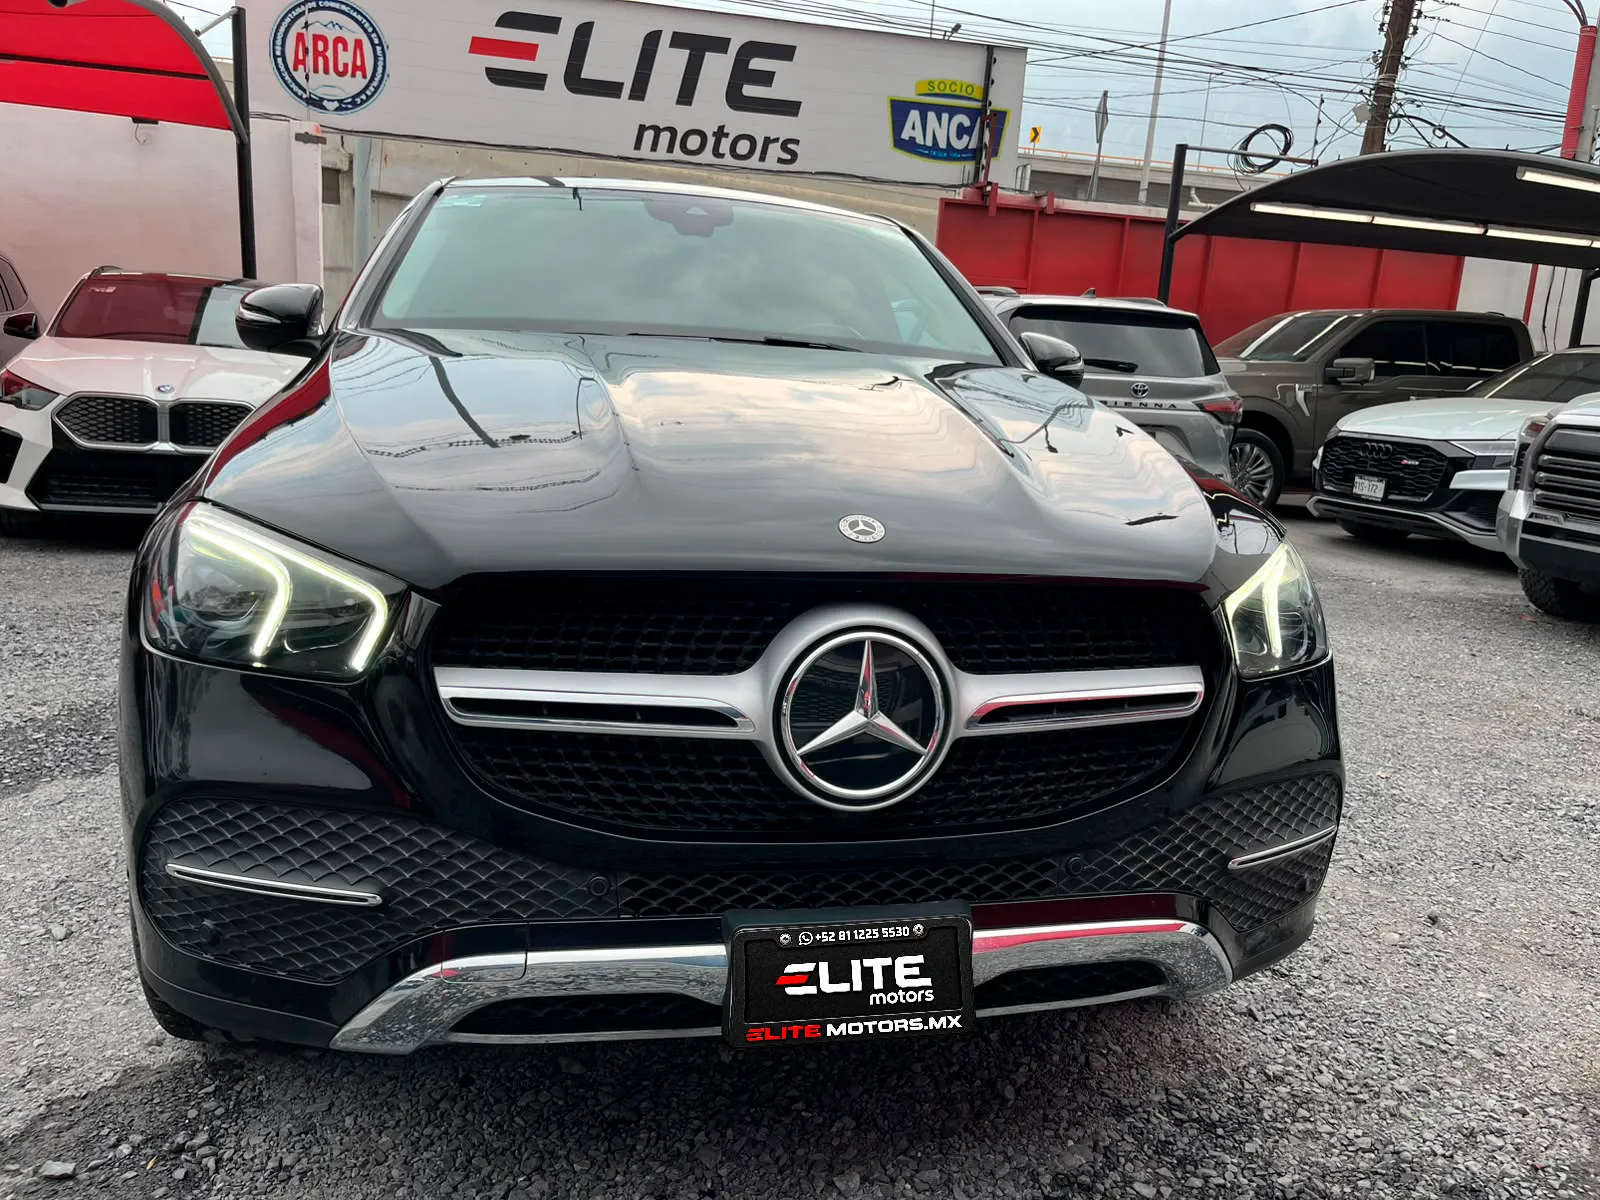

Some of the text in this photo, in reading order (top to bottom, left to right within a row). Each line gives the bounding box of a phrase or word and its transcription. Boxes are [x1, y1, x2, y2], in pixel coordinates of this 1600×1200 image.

[292, 31, 368, 80] ARCA
[468, 11, 802, 118] ELITE
[927, 80, 975, 96] SOCIO
[633, 123, 800, 165] motors
[815, 926, 910, 943] +52 81 1225 5530
[775, 954, 933, 996] ELITE
[869, 989, 935, 1006] motors
[745, 1014, 963, 1042] ELITE MOTORS.MX
